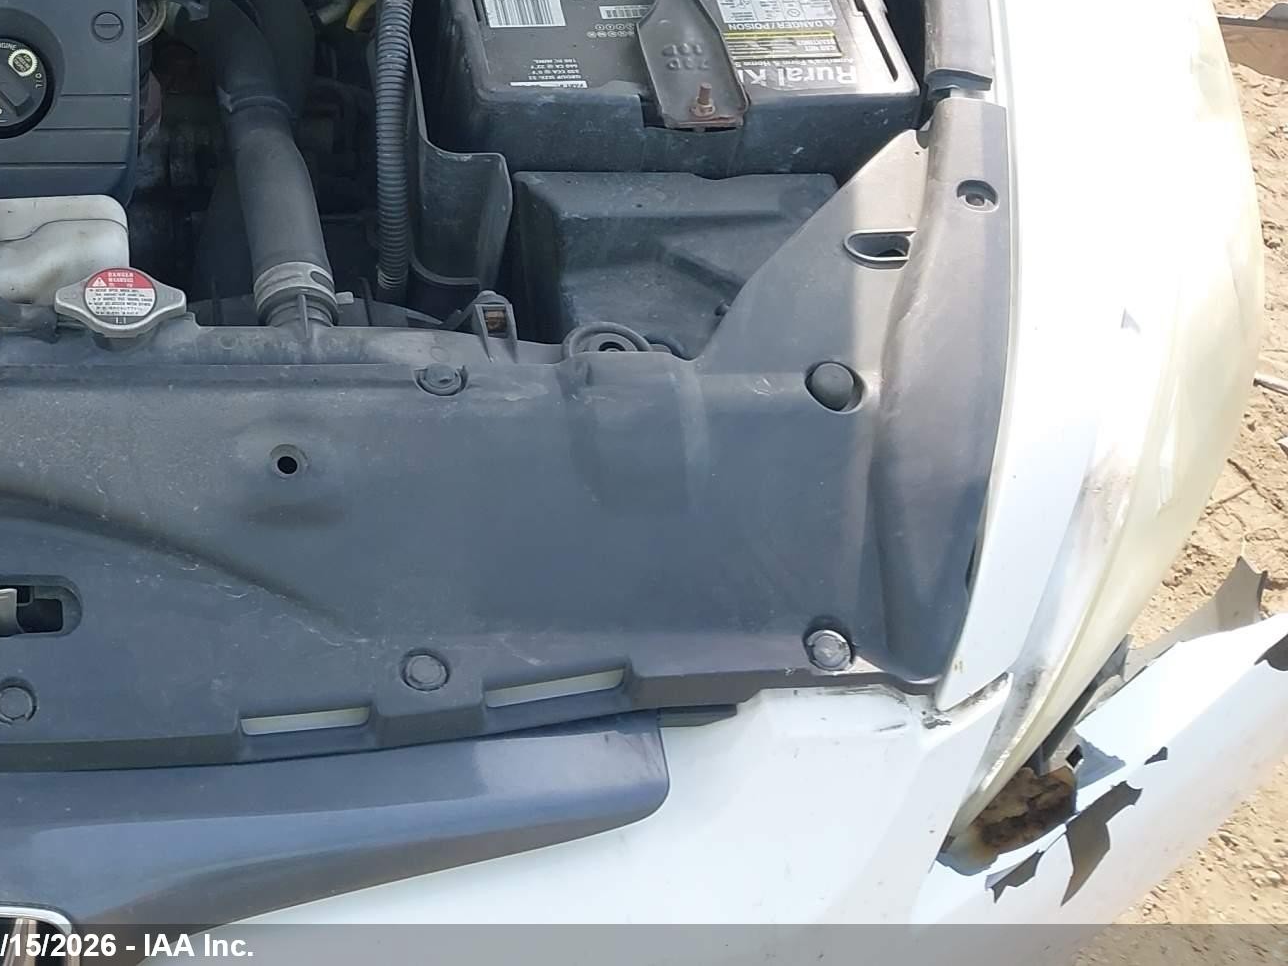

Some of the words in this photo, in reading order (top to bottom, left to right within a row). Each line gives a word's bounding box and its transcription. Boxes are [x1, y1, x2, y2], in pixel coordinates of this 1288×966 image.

[728, 22, 770, 30] POISON
[35, 73, 44, 89] OIL
[737, 68, 766, 85] K
[777, 65, 857, 87] Rural
